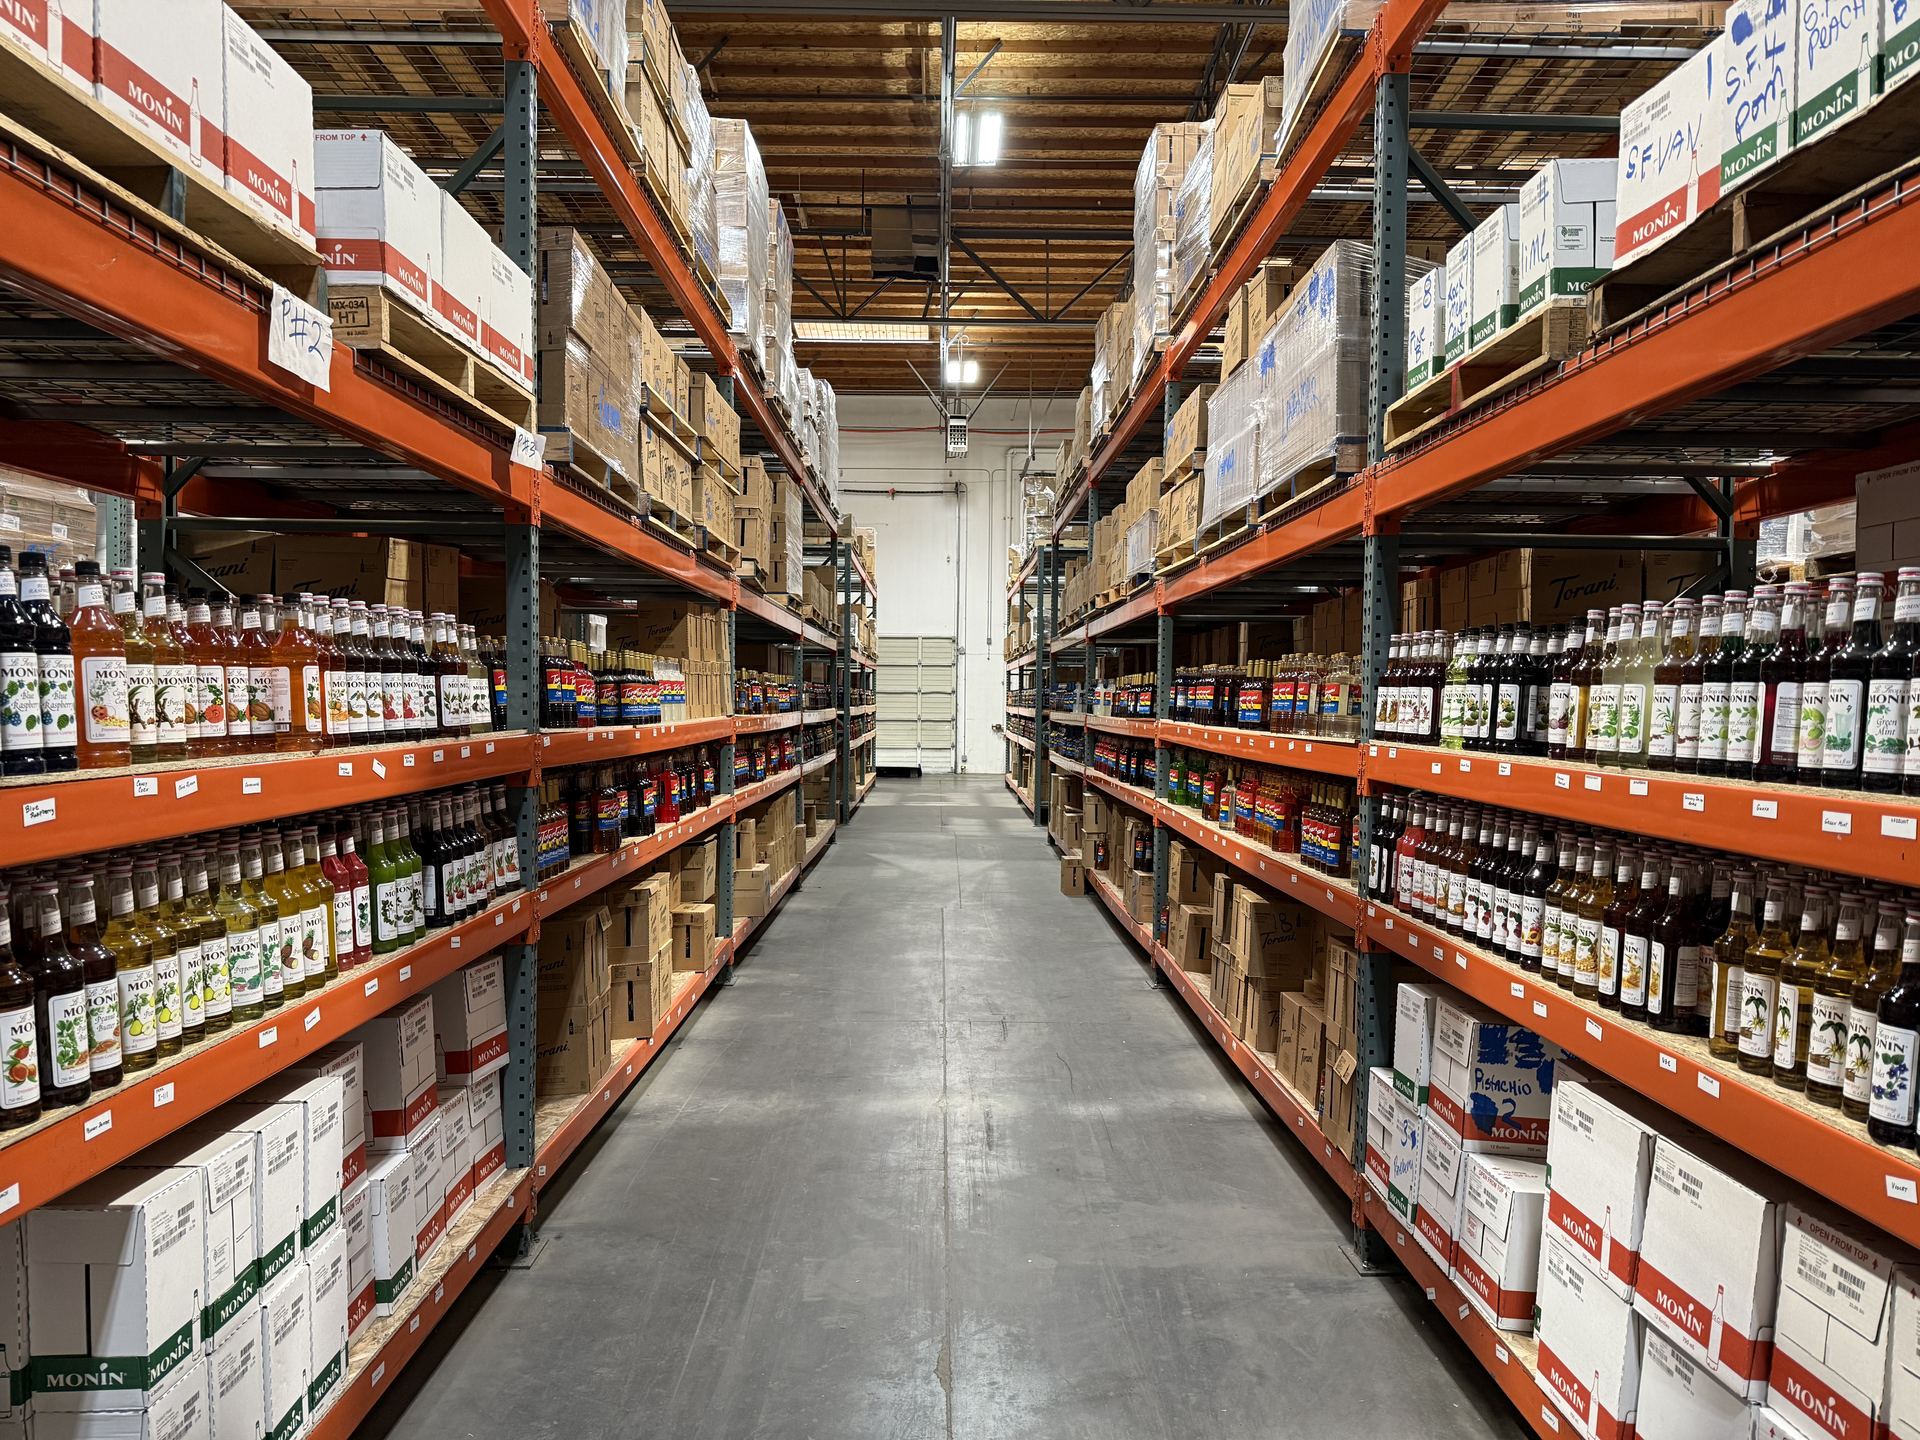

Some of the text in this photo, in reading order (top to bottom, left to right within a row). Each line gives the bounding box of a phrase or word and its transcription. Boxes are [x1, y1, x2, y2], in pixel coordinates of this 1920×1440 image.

[128, 80, 184, 133] MONIN
[1801, 86, 1855, 136] MONIN
[315, 133, 356, 142] FROM TOP
[1724, 137, 1774, 180] MONIN
[248, 168, 288, 209] MONIN
[1632, 201, 1681, 244] MONIN
[399, 269, 424, 295] MONIN
[331, 300, 365, 311] MX-034
[1520, 286, 1544, 313] MONIN
[338, 311, 358, 325] HT
[452, 312, 475, 334] MONIN
[1473, 318, 1495, 343] MONIN
[499, 347, 520, 368] MONIN
[1549, 573, 1617, 608] Torani
[96, 670, 127, 679] MON
[1876, 714, 1898, 728] Green
[1876, 727, 1896, 737] Mint
[1261, 931, 1296, 947] Torani
[127, 979, 154, 992] MON
[477, 1040, 501, 1064] MONIN
[411, 1095, 433, 1126] MONIN
[1433, 1097, 1456, 1124] MONIN
[1502, 1098, 1522, 1130] 2
[1491, 1123, 1547, 1141] MONIN
[480, 1152, 499, 1178] MONIN
[1369, 1155, 1388, 1183] MONIN
[1478, 1169, 1487, 1181] OPEN
[1487, 1177, 1497, 1189] FROM
[310, 1206, 336, 1241] MONIN
[419, 1220, 439, 1255] MONIN
[1421, 1219, 1444, 1250] MONIN
[1562, 1213, 1597, 1251] MONIN
[1809, 1222, 1869, 1263] OPEN FROM TOP
[264, 1242, 295, 1280] MONIN
[392, 1262, 412, 1296] MONIN
[1463, 1265, 1490, 1298] MONIN
[220, 1280, 254, 1323] MONIN
[1656, 1289, 1704, 1337] MONIN
[150, 1335, 191, 1382] MONIN
[47, 1362, 124, 1387] MONIN
[314, 1363, 340, 1402] MONIN
[1550, 1367, 1586, 1413] MONIN
[1787, 1377, 1848, 1437] MONIN
